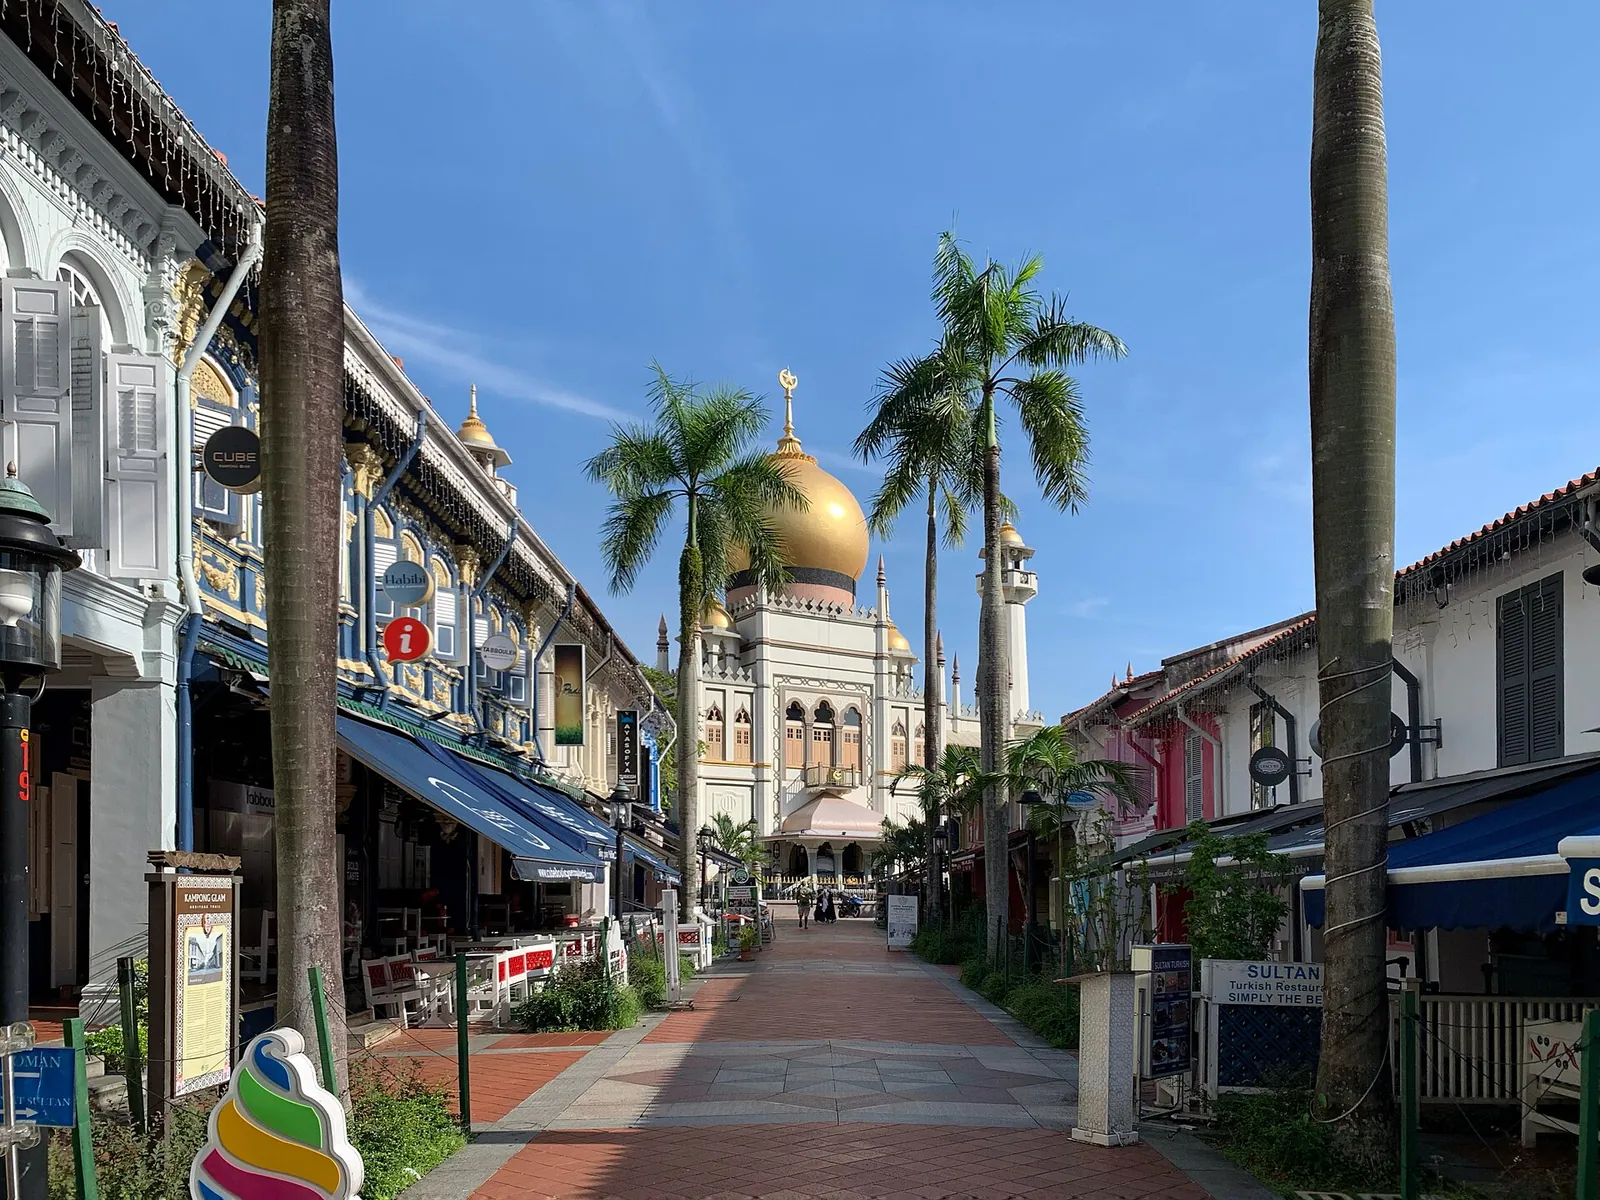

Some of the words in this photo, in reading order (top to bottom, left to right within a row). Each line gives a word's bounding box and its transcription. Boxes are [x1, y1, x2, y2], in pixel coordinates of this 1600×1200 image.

[213, 452, 256, 462] CUBE
[385, 574, 426, 585] Habibi
[184, 893, 210, 902] KAMPONG
[211, 893, 226, 902] GLAM
[1154, 961, 1171, 970] SULTAN
[1170, 960, 1190, 969] TURKISH
[1247, 964, 1320, 980] SULTAN
[1229, 980, 1272, 991] Turkish
[1228, 992, 1273, 1003] SIMPLY
[1277, 994, 1302, 1004] THE
[1306, 995, 1323, 1005] BE
[27, 1096, 71, 1107] SULTAN
